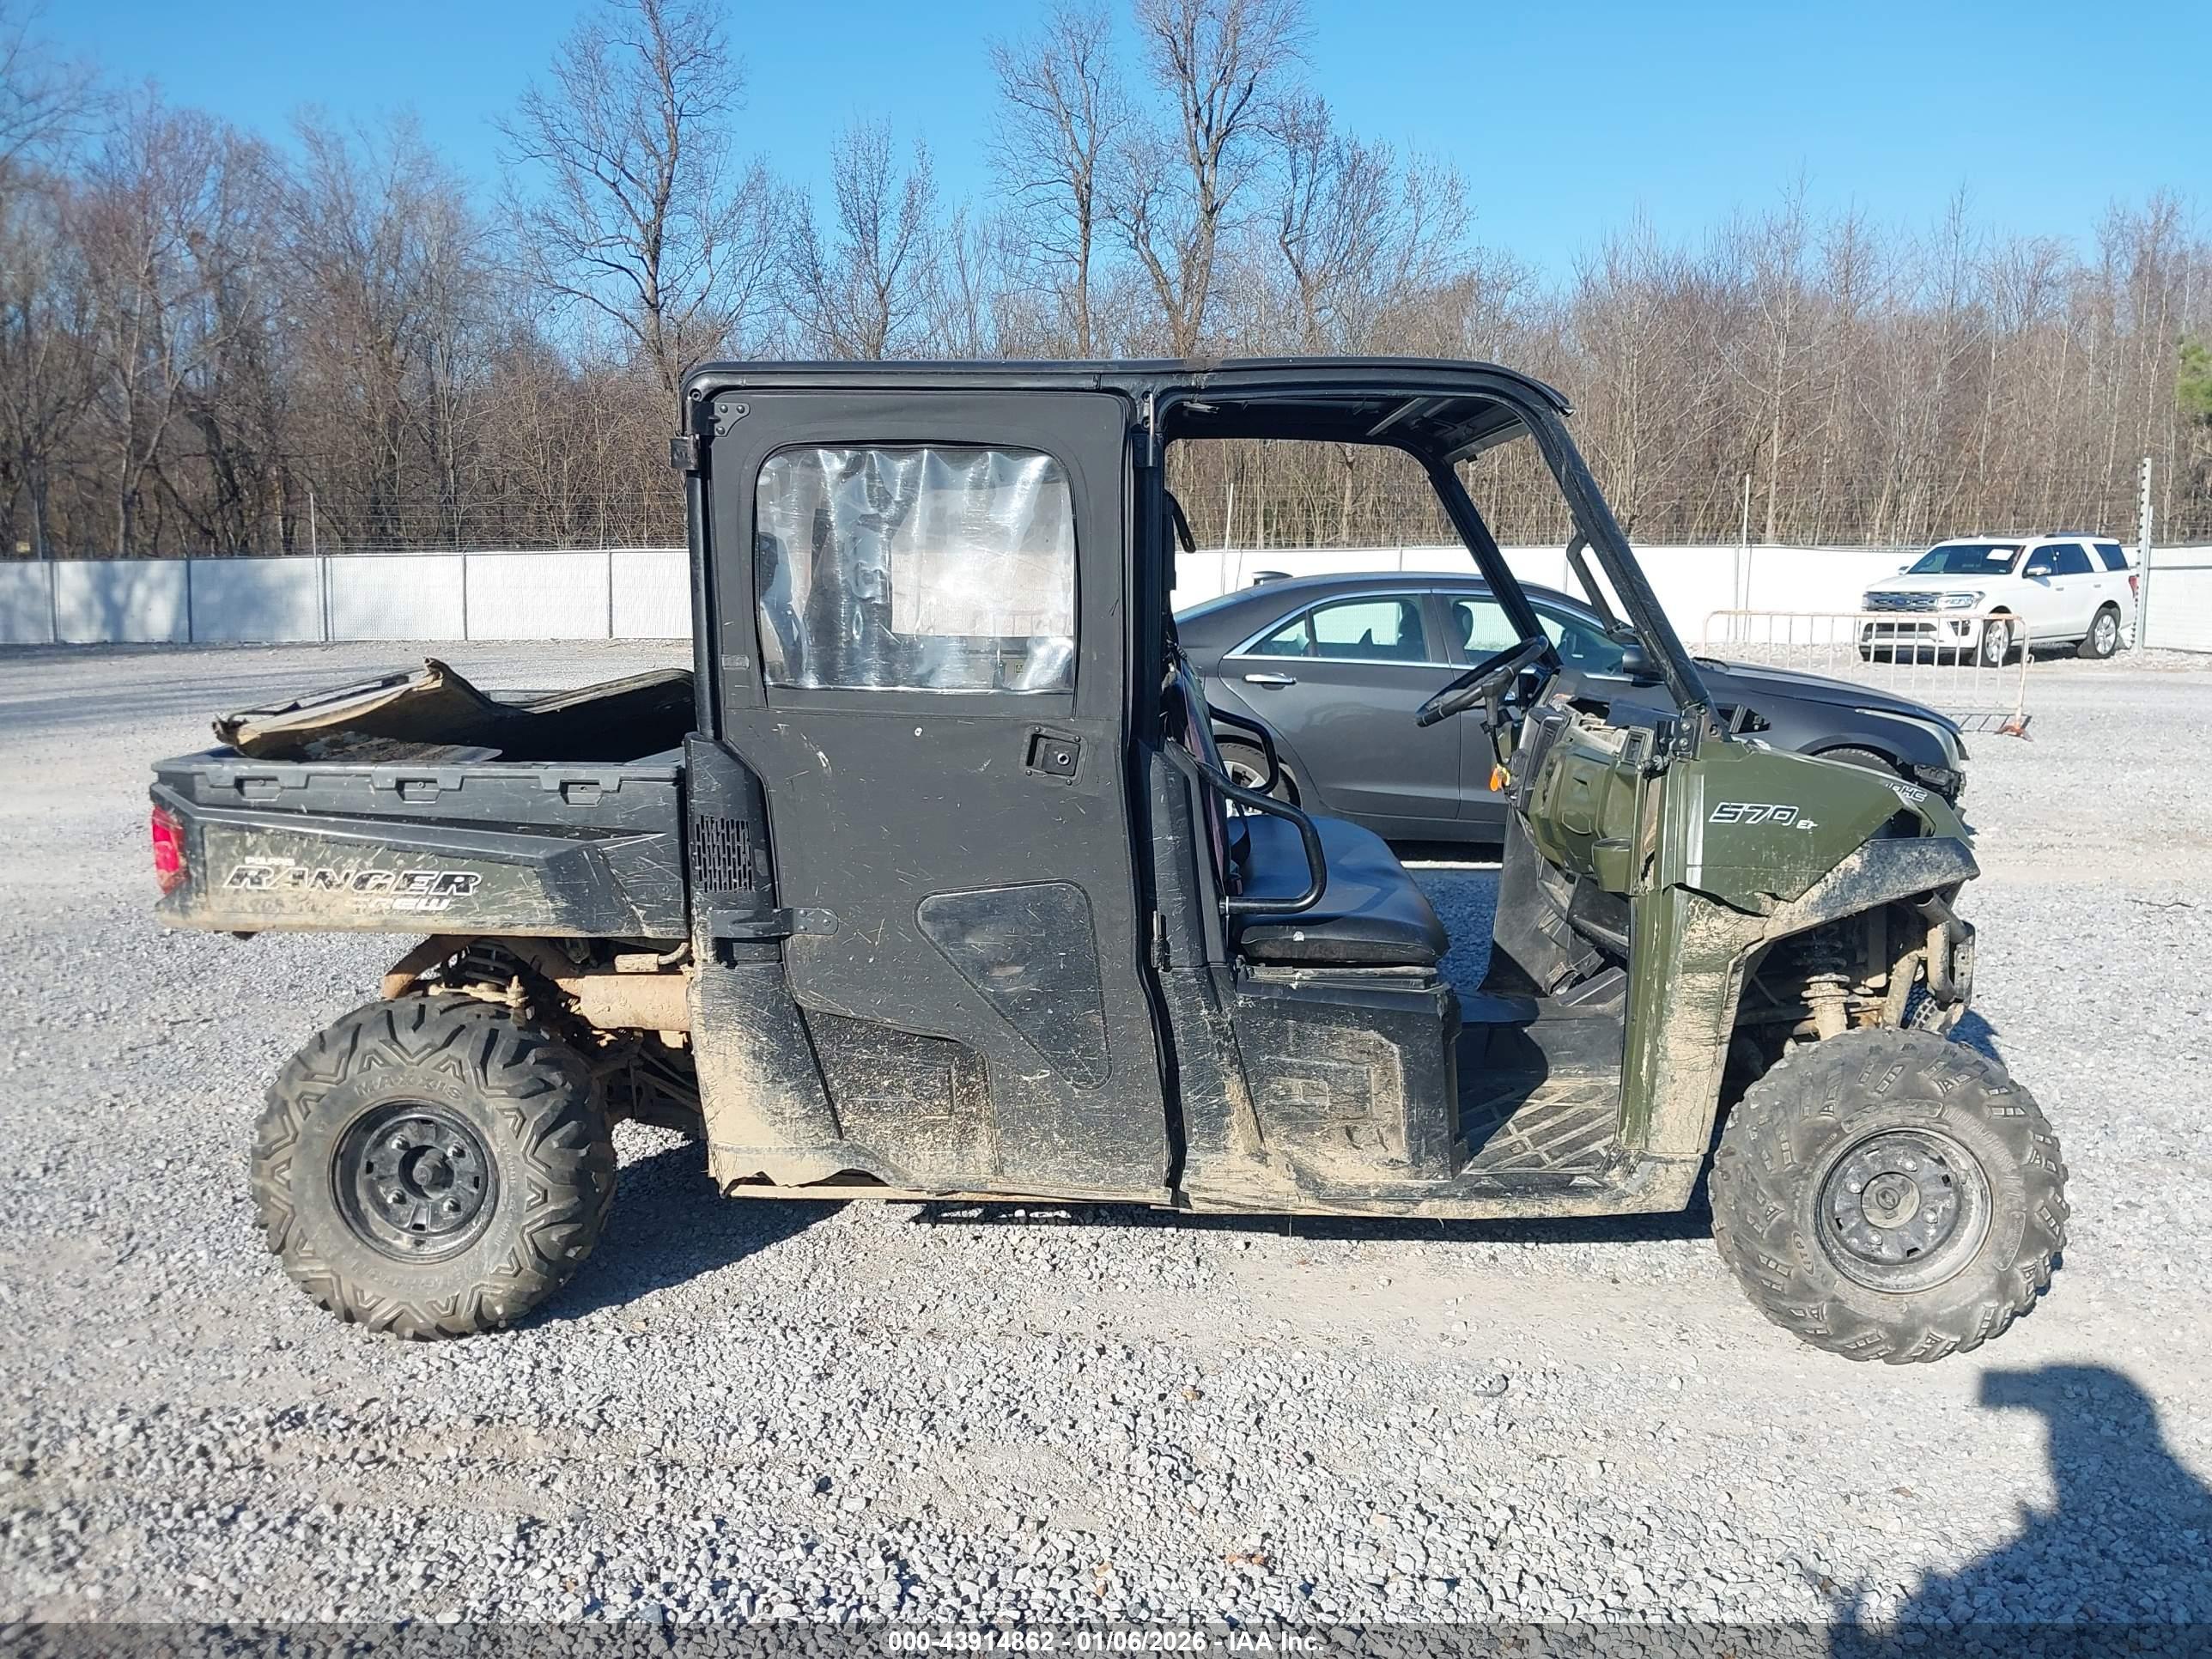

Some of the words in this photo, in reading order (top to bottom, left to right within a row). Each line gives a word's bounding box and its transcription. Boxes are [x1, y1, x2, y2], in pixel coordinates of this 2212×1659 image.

[1709, 802, 1799, 826] 570
[245, 856, 295, 866] POLARIS
[222, 865, 482, 896] RANGER
[355, 1074, 463, 1100] MAXXIS
